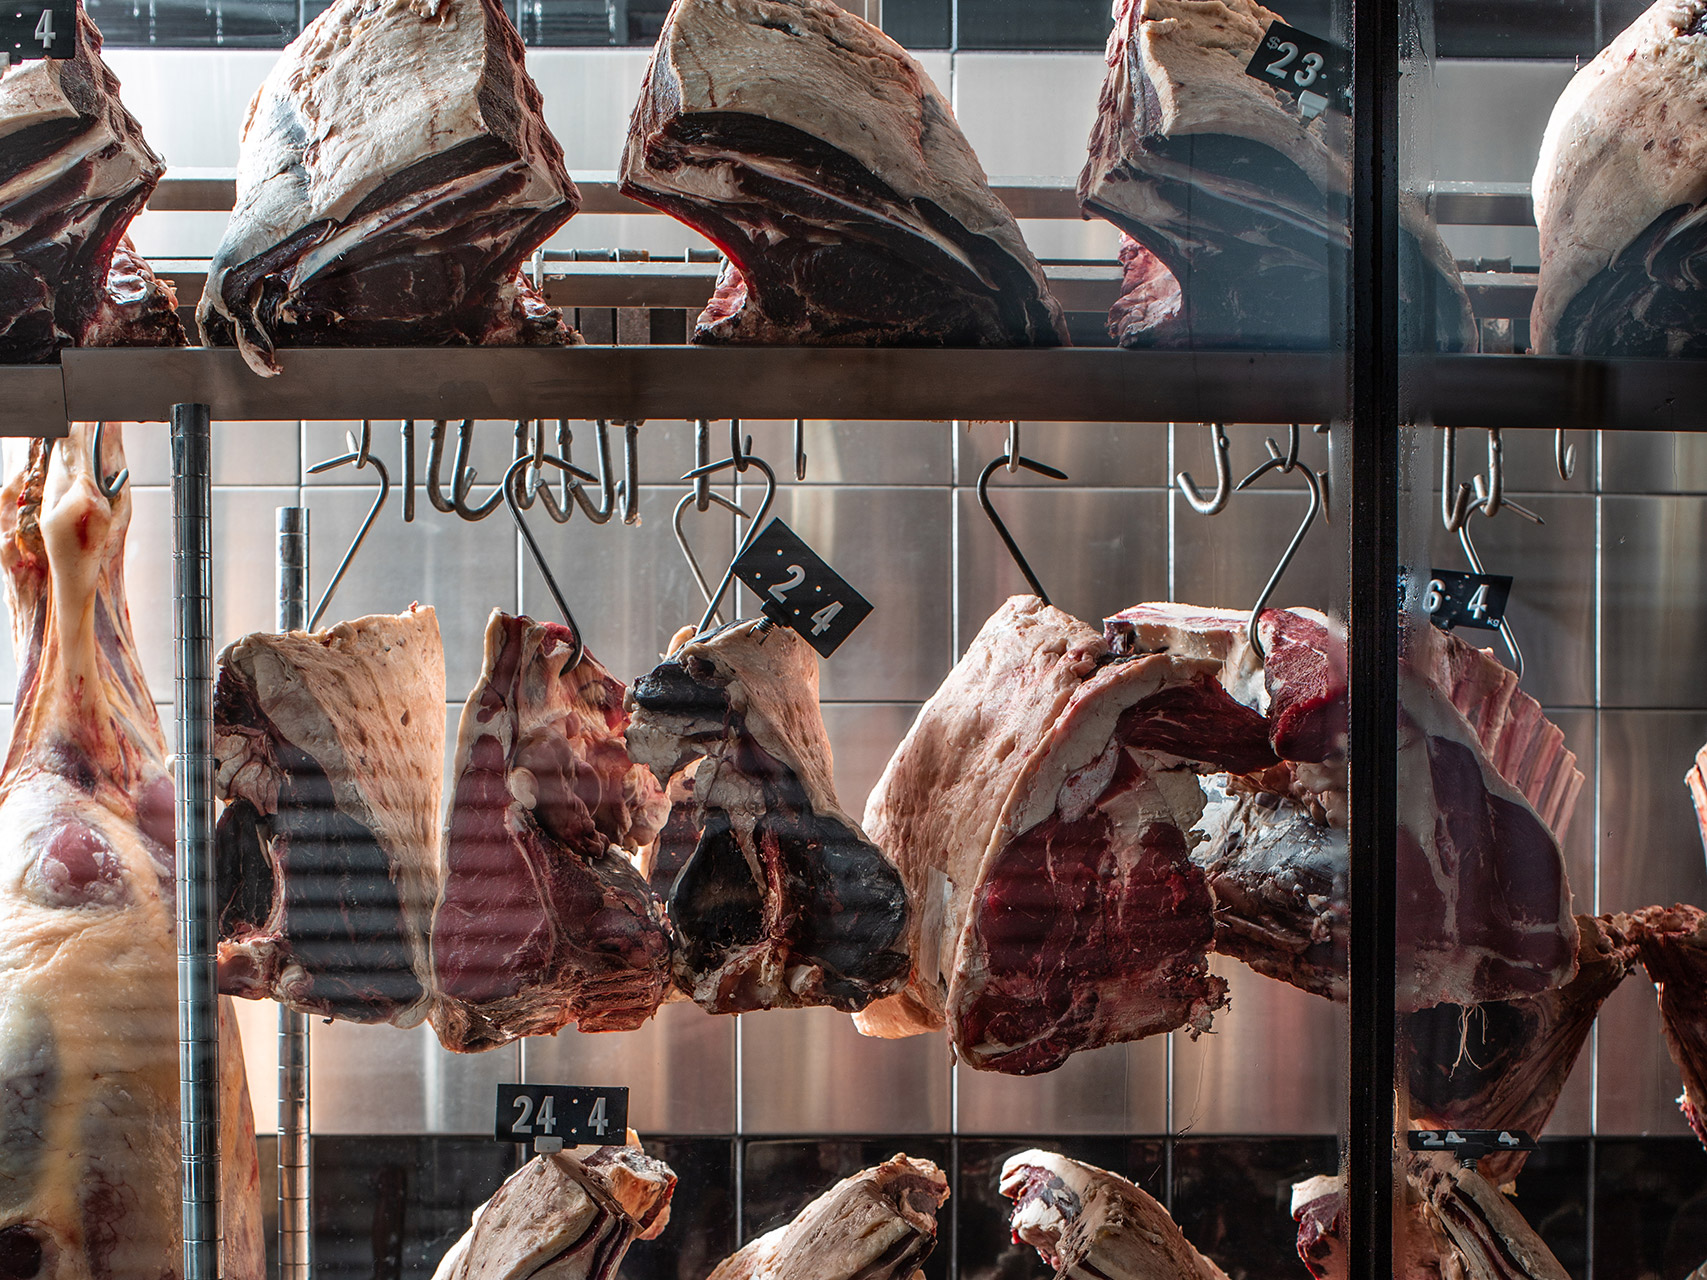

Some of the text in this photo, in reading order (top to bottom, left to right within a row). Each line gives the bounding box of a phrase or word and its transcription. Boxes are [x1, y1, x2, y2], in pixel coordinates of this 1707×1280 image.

[35, 9, 56, 49] 4
[1467, 583, 1490, 619] 4
[511, 1095, 609, 1136] 24 4
